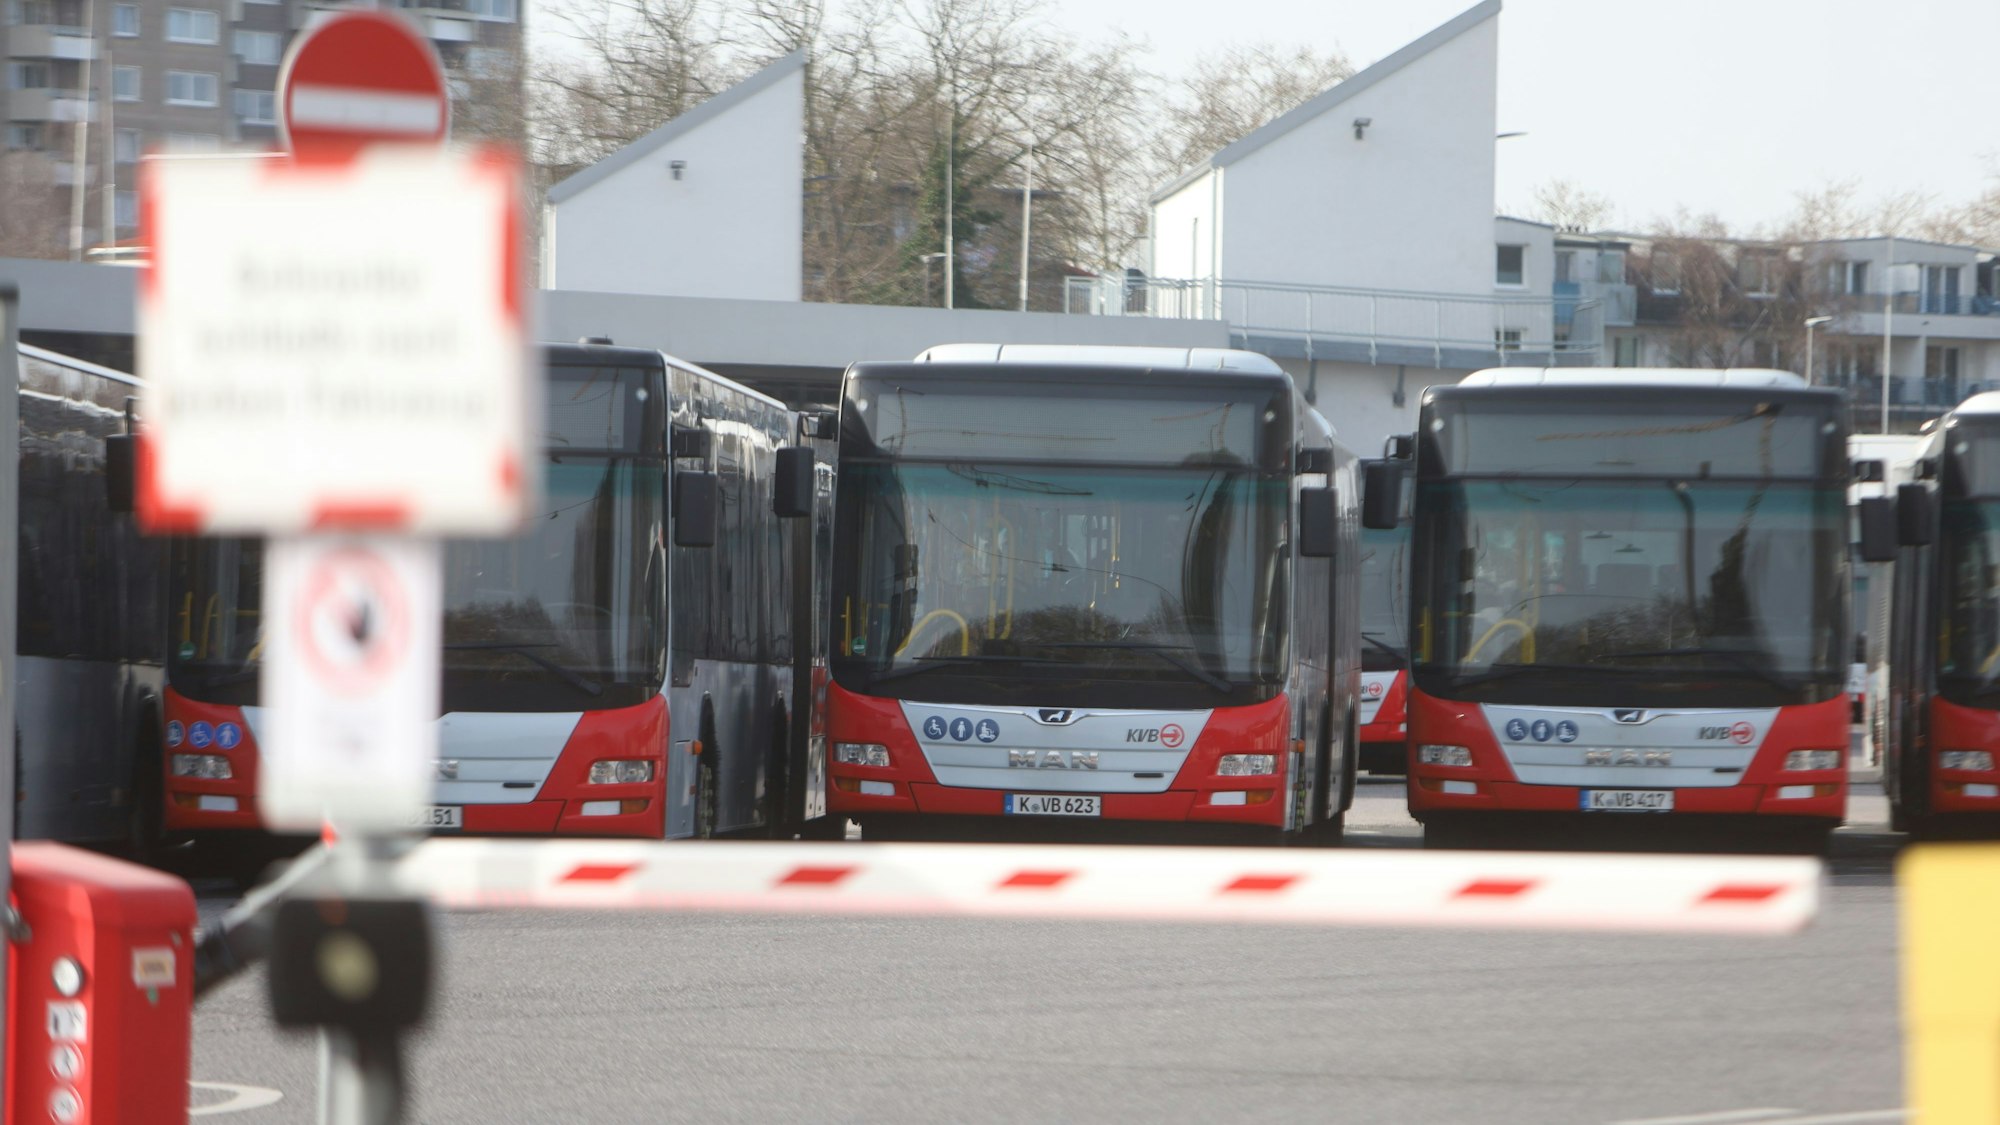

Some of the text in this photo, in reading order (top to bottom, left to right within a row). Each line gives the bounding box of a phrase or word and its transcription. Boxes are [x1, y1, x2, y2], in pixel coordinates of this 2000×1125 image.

[1126, 729, 1159, 742] KVB
[1698, 727, 1730, 739] KVB
[1009, 750, 1098, 769] MAN
[1585, 747, 1672, 767] MAN
[1020, 797, 1094, 814] K VB 623
[1593, 792, 1666, 808] K VB 417
